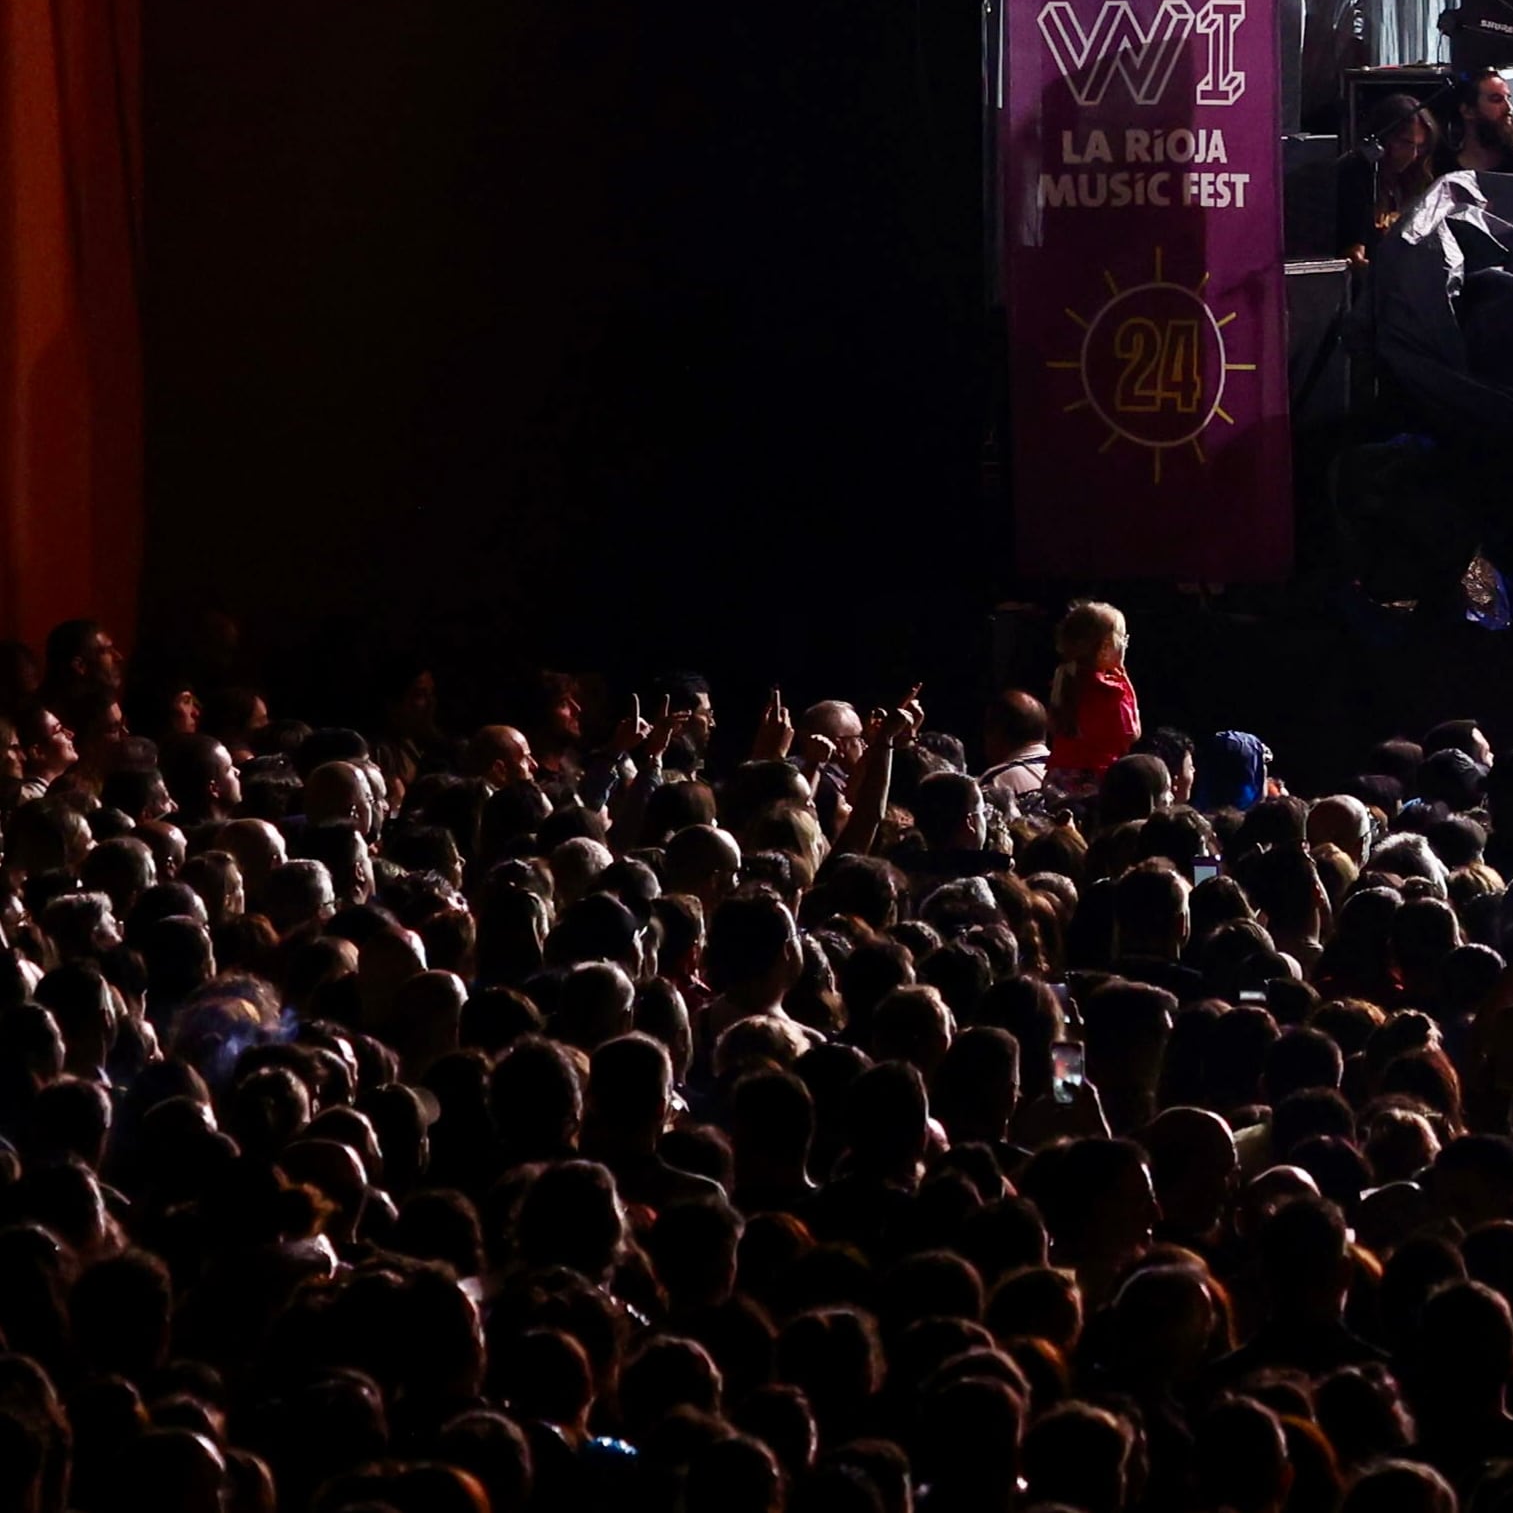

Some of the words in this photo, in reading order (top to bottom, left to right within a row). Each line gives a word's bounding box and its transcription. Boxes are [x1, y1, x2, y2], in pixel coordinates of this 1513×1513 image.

[1062, 128, 1113, 165] LA
[1184, 171, 1250, 208] FEST
[1114, 319, 1201, 413] 24
